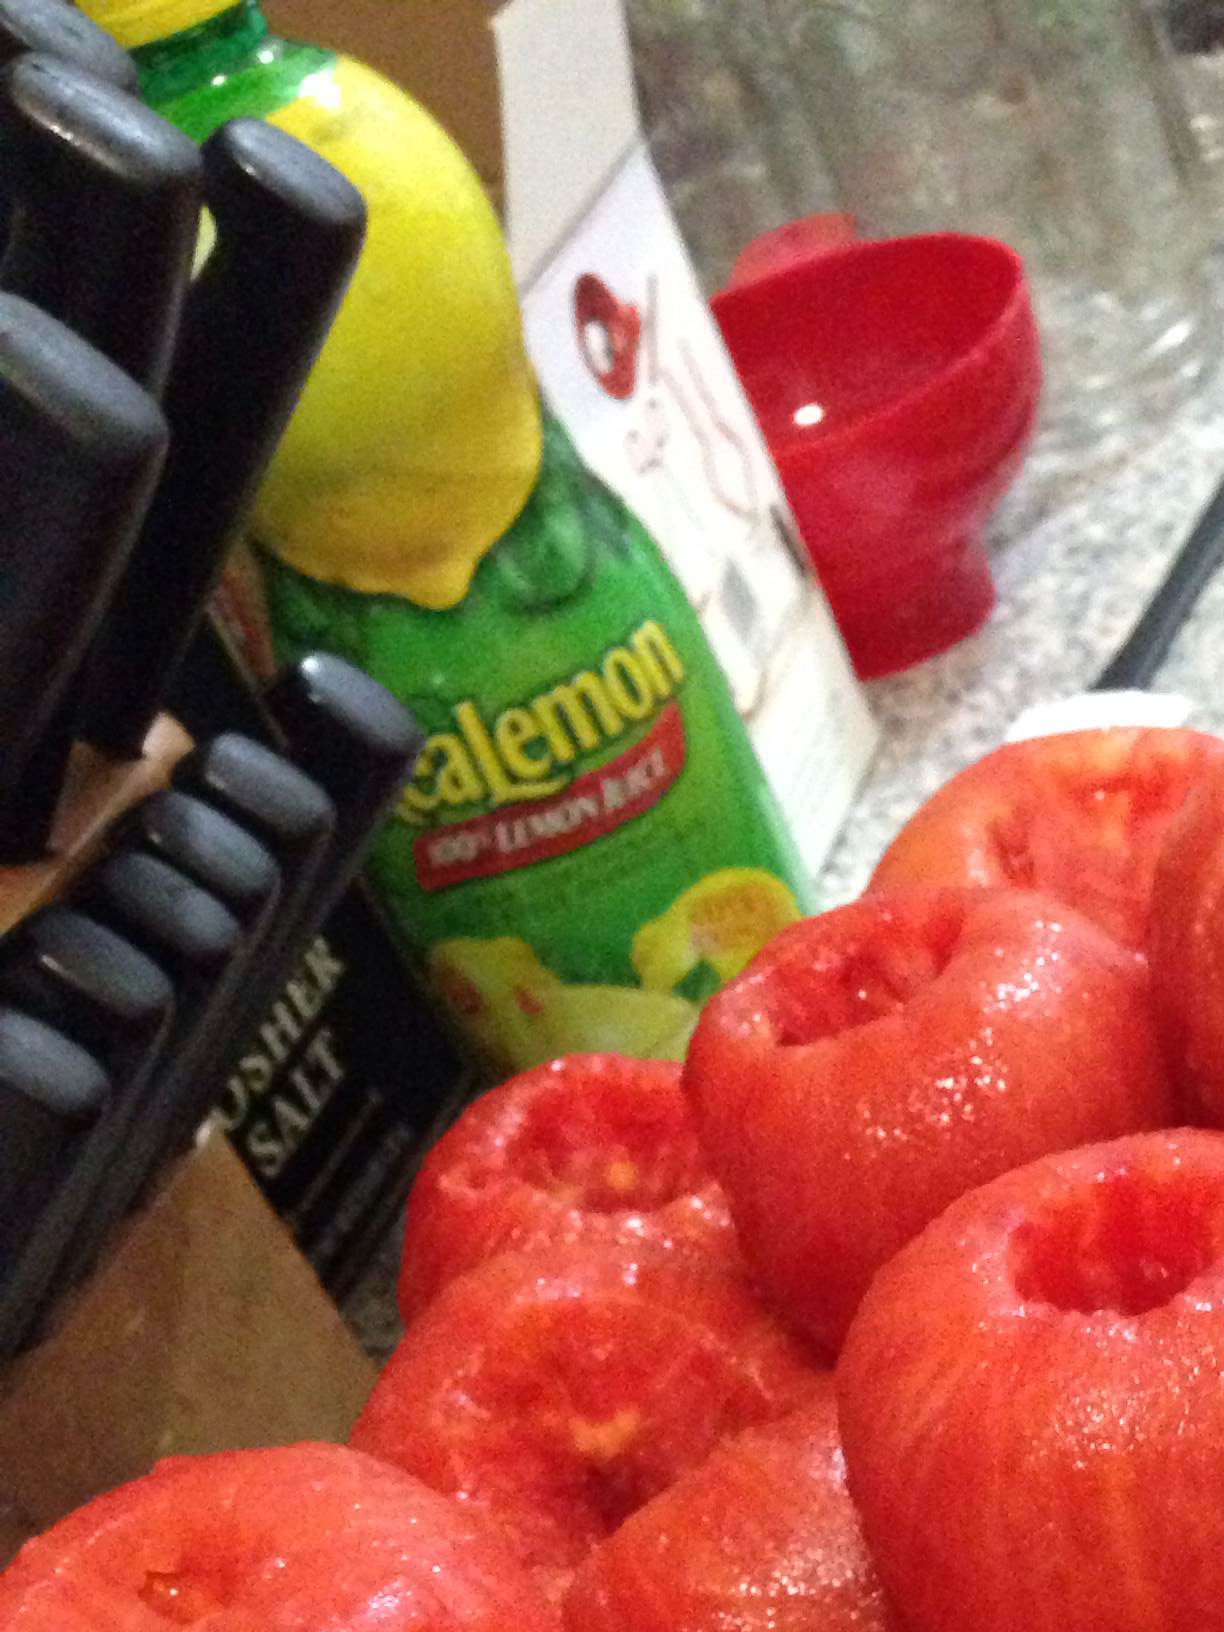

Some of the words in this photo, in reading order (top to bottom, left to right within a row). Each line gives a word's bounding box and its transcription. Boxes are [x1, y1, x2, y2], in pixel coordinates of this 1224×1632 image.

[393, 620, 684, 824] aLemon
[211, 935, 345, 1132] OSHER
[246, 1028, 345, 1179] SALT
